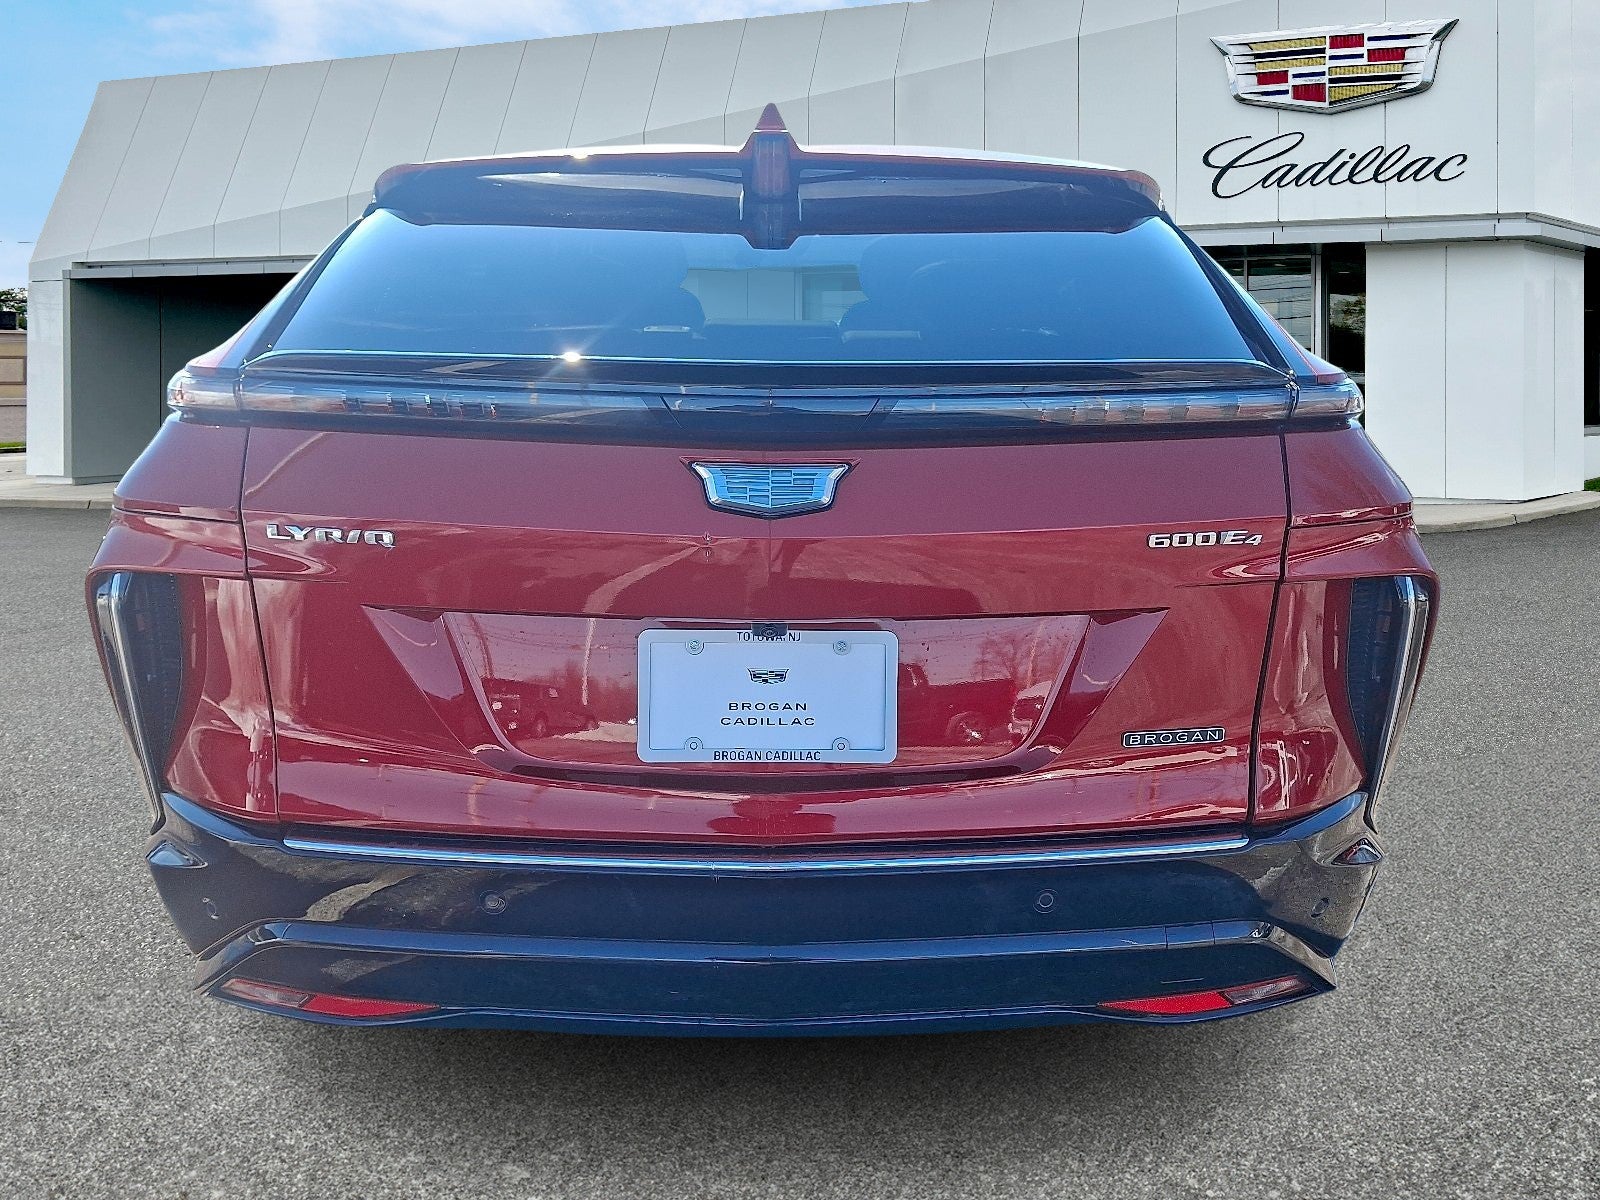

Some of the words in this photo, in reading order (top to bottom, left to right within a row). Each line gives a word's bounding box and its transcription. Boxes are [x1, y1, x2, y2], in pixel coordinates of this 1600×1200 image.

[1202, 131, 1468, 199] Cadillac
[266, 523, 396, 548] LYRIQ
[788, 631, 801, 642] NJ
[728, 702, 807, 711] BROGAN
[720, 717, 815, 726] CADILLAC
[1129, 730, 1219, 745] BROGAN
[713, 750, 762, 761] BROGAN
[765, 750, 821, 761] CADILLAC
